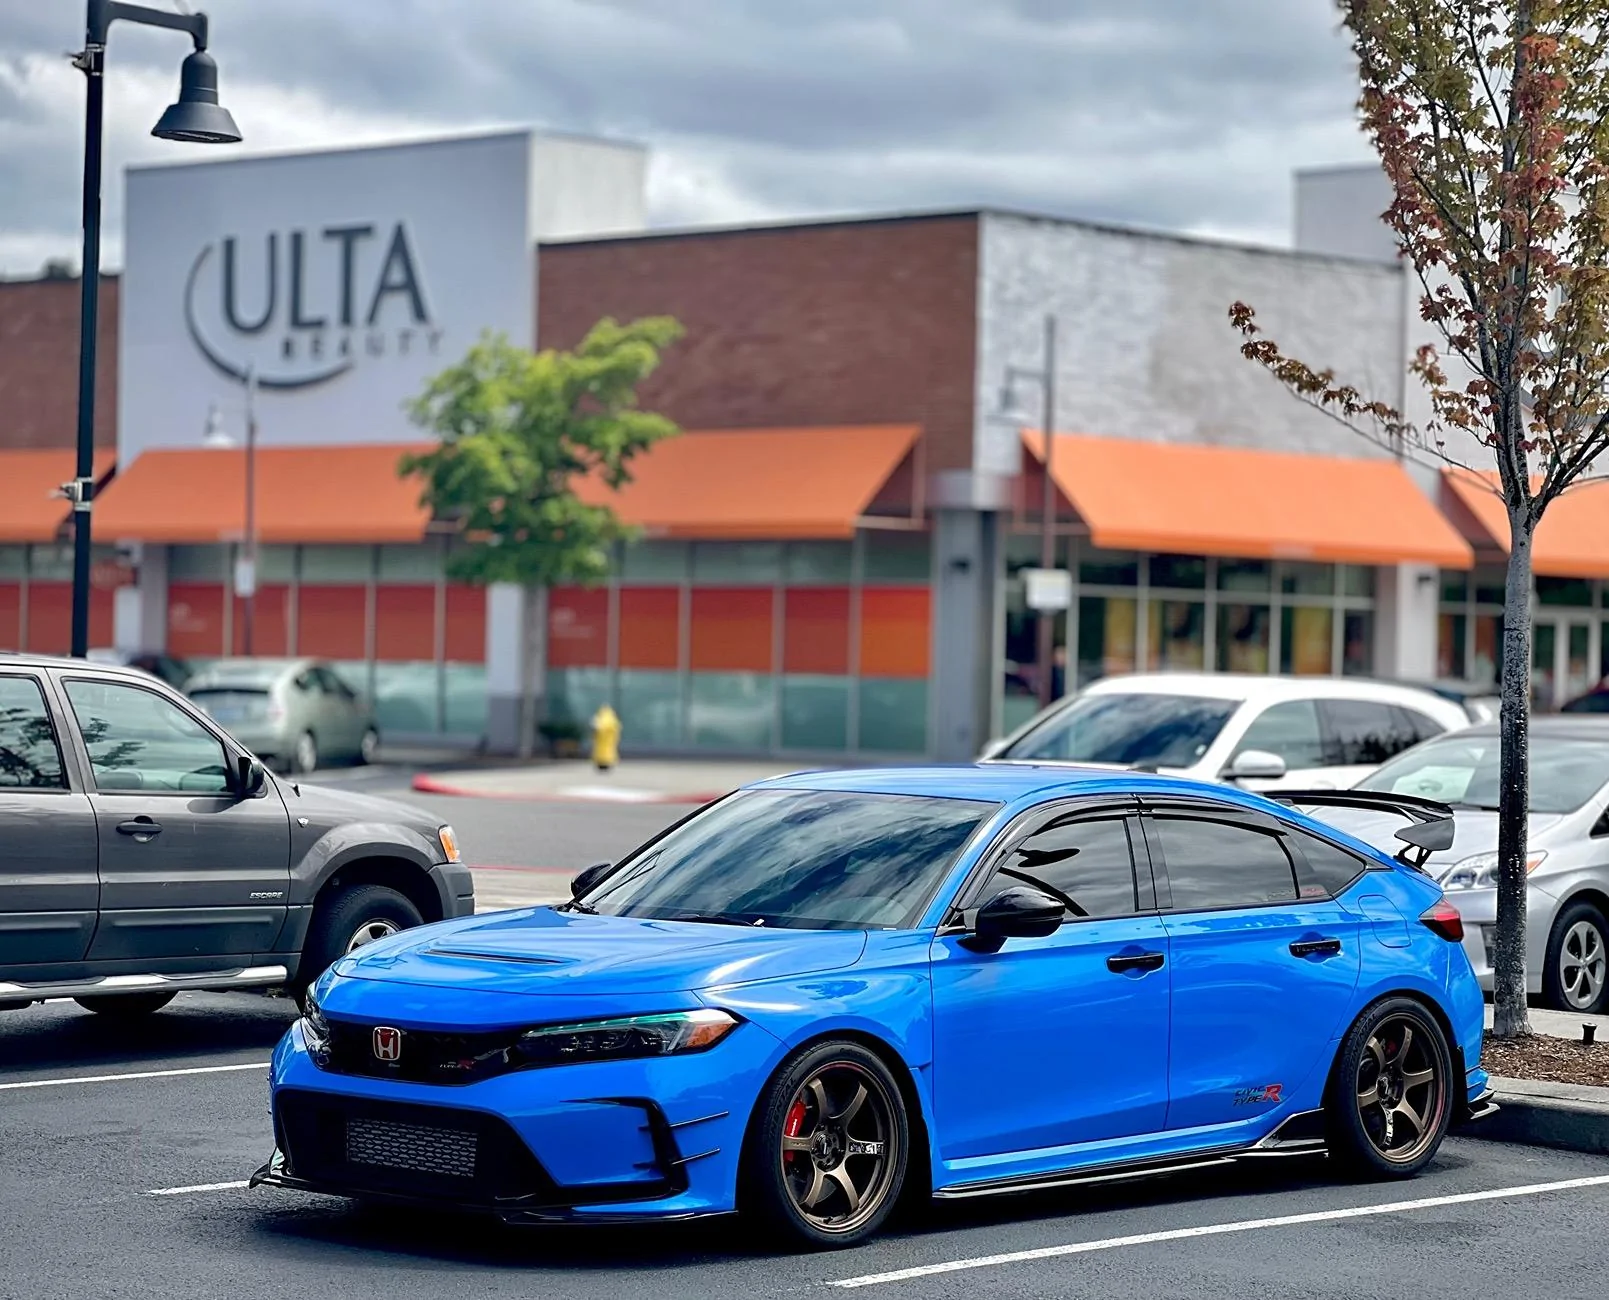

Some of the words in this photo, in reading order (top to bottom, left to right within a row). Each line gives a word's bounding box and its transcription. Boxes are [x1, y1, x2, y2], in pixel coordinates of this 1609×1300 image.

[222, 221, 428, 335] ULTA
[282, 327, 444, 361] BEAUTY
[1263, 1083, 1283, 1103] R
